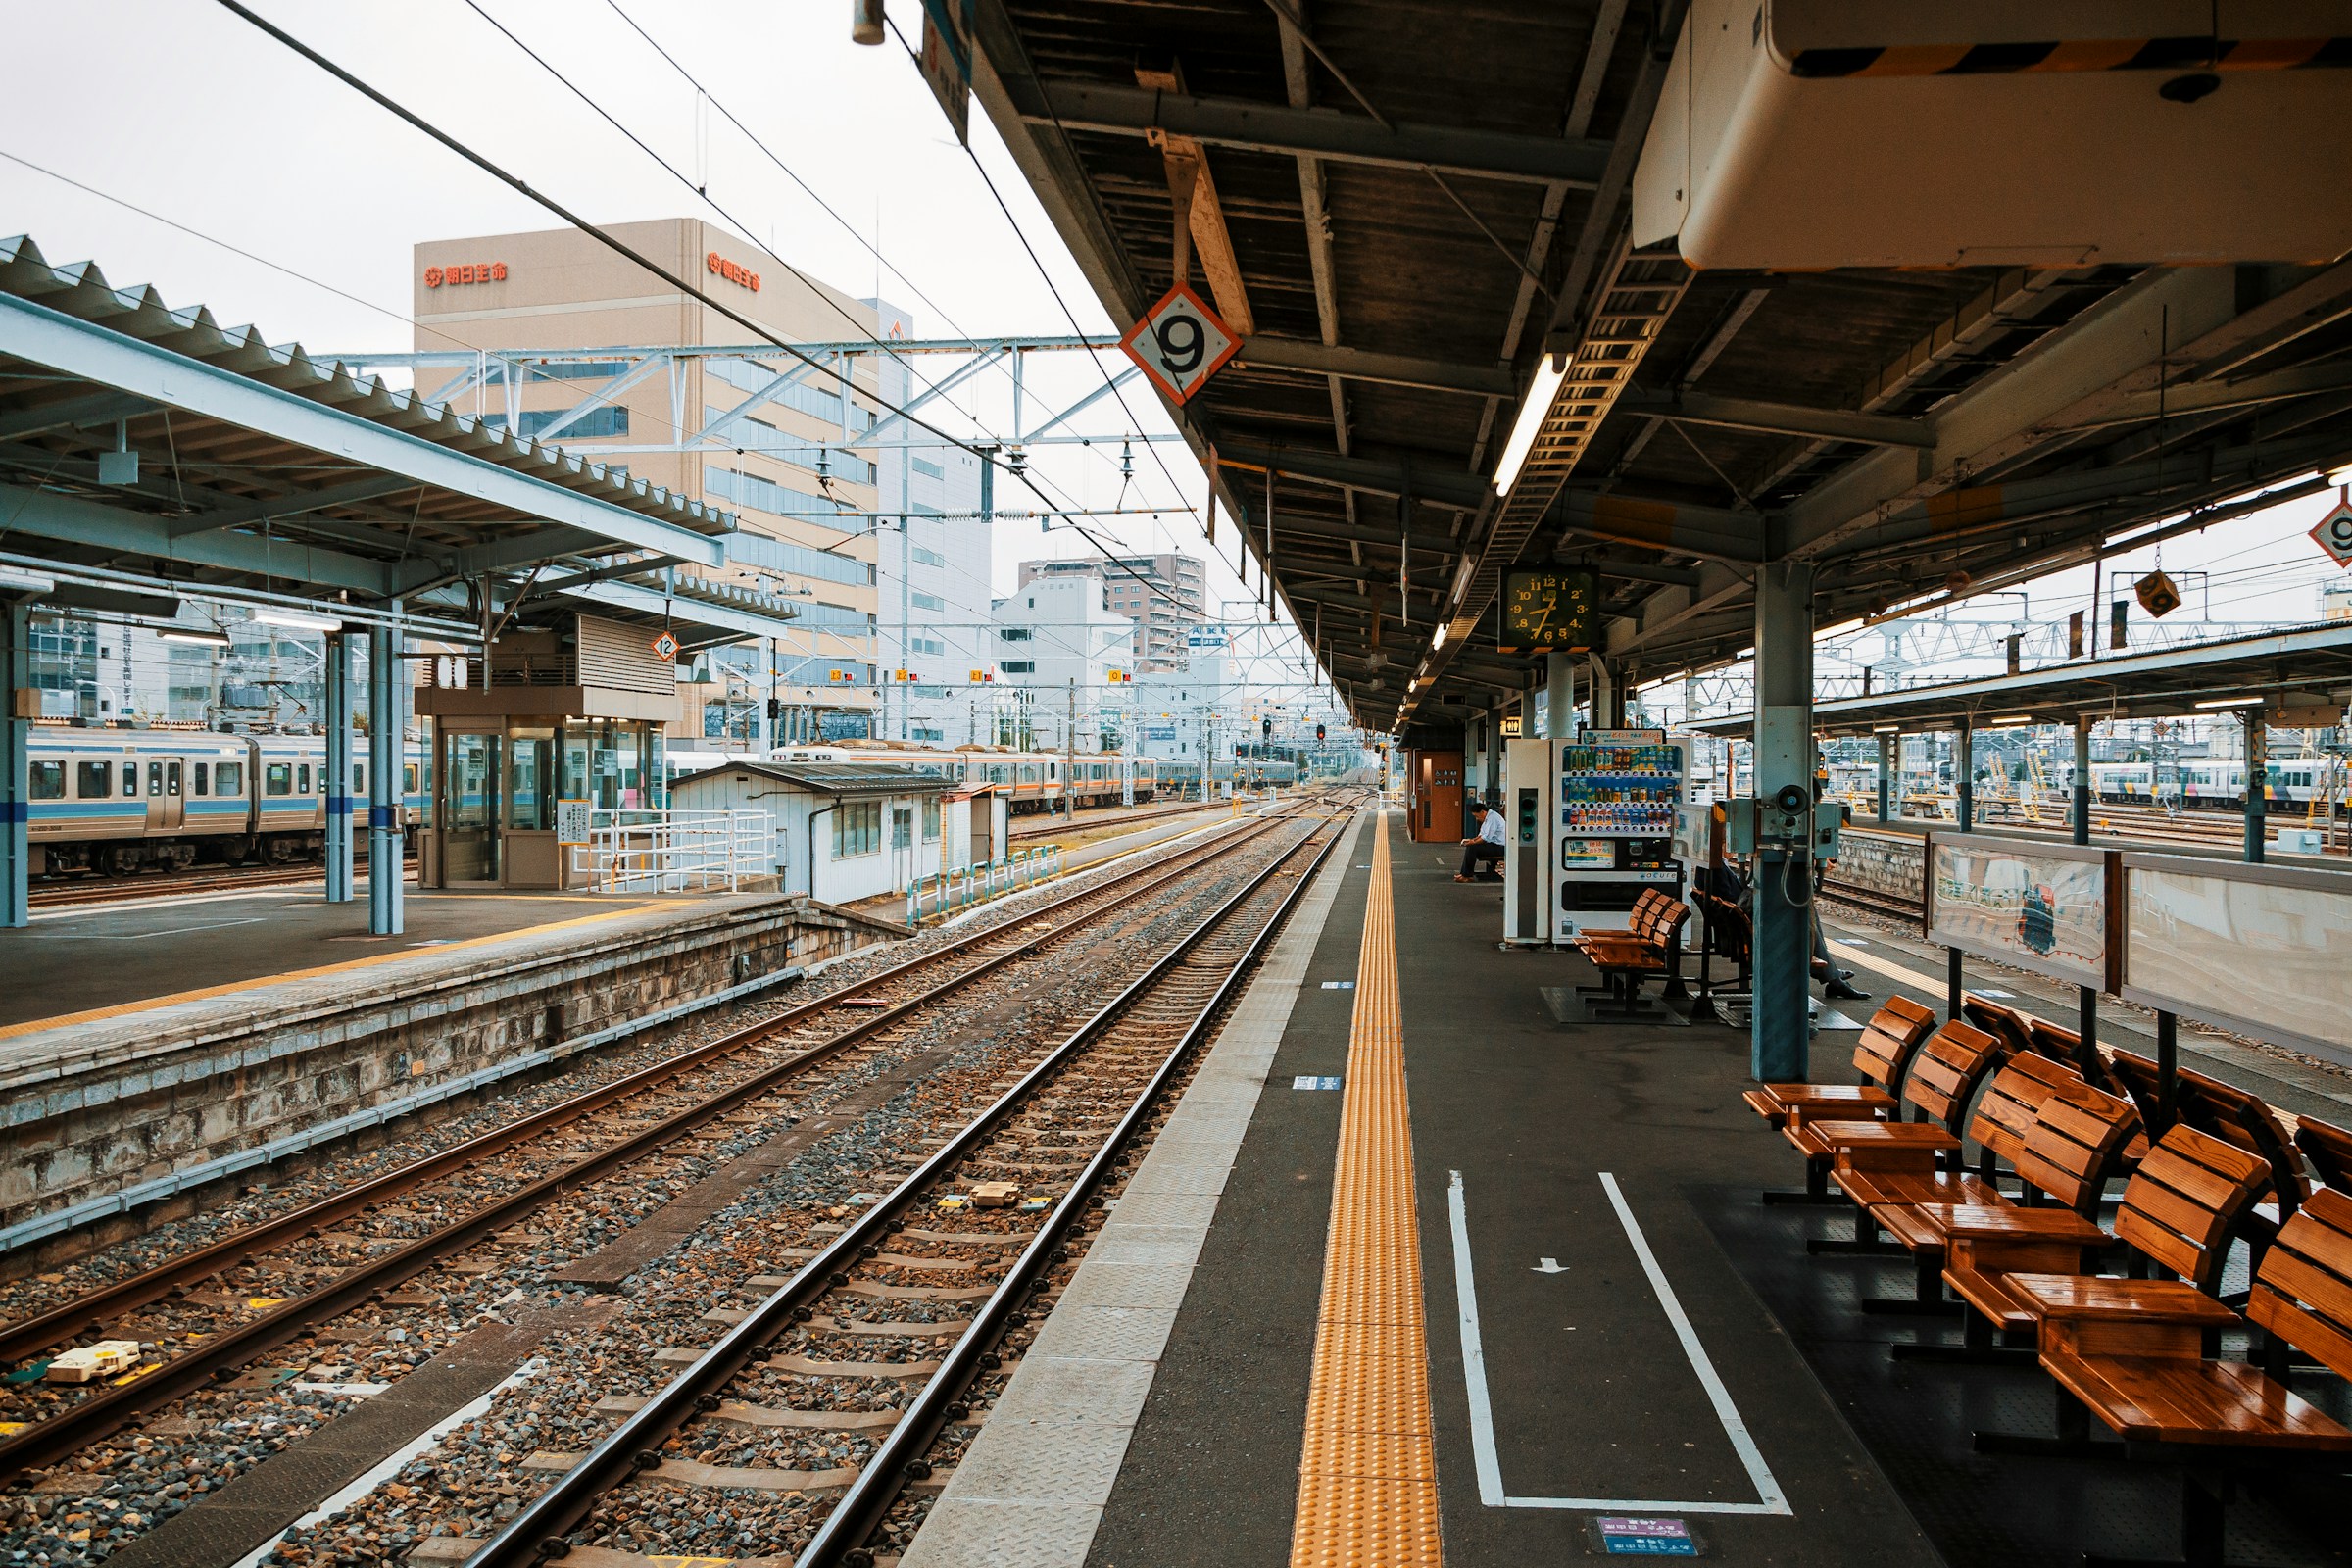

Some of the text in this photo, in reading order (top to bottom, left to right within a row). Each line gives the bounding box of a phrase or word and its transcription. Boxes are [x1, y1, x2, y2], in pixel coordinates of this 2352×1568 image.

[445, 261, 508, 285] 朝日生命
[721, 258, 761, 292] 朝日生命
[1158, 315, 1205, 373] 9
[2331, 517, 2352, 551] 9
[1544, 578, 1555, 587] 12
[1561, 581, 1566, 590] 1
[1513, 605, 1522, 613] 9
[1576, 605, 1585, 613] 3
[1520, 618, 1528, 627] 8
[1544, 631, 1553, 640] 6
[1558, 628, 1567, 637] 5
[660, 640, 672, 654] 12
[896, 670, 907, 680] 上2
[971, 670, 981, 680] 上1
